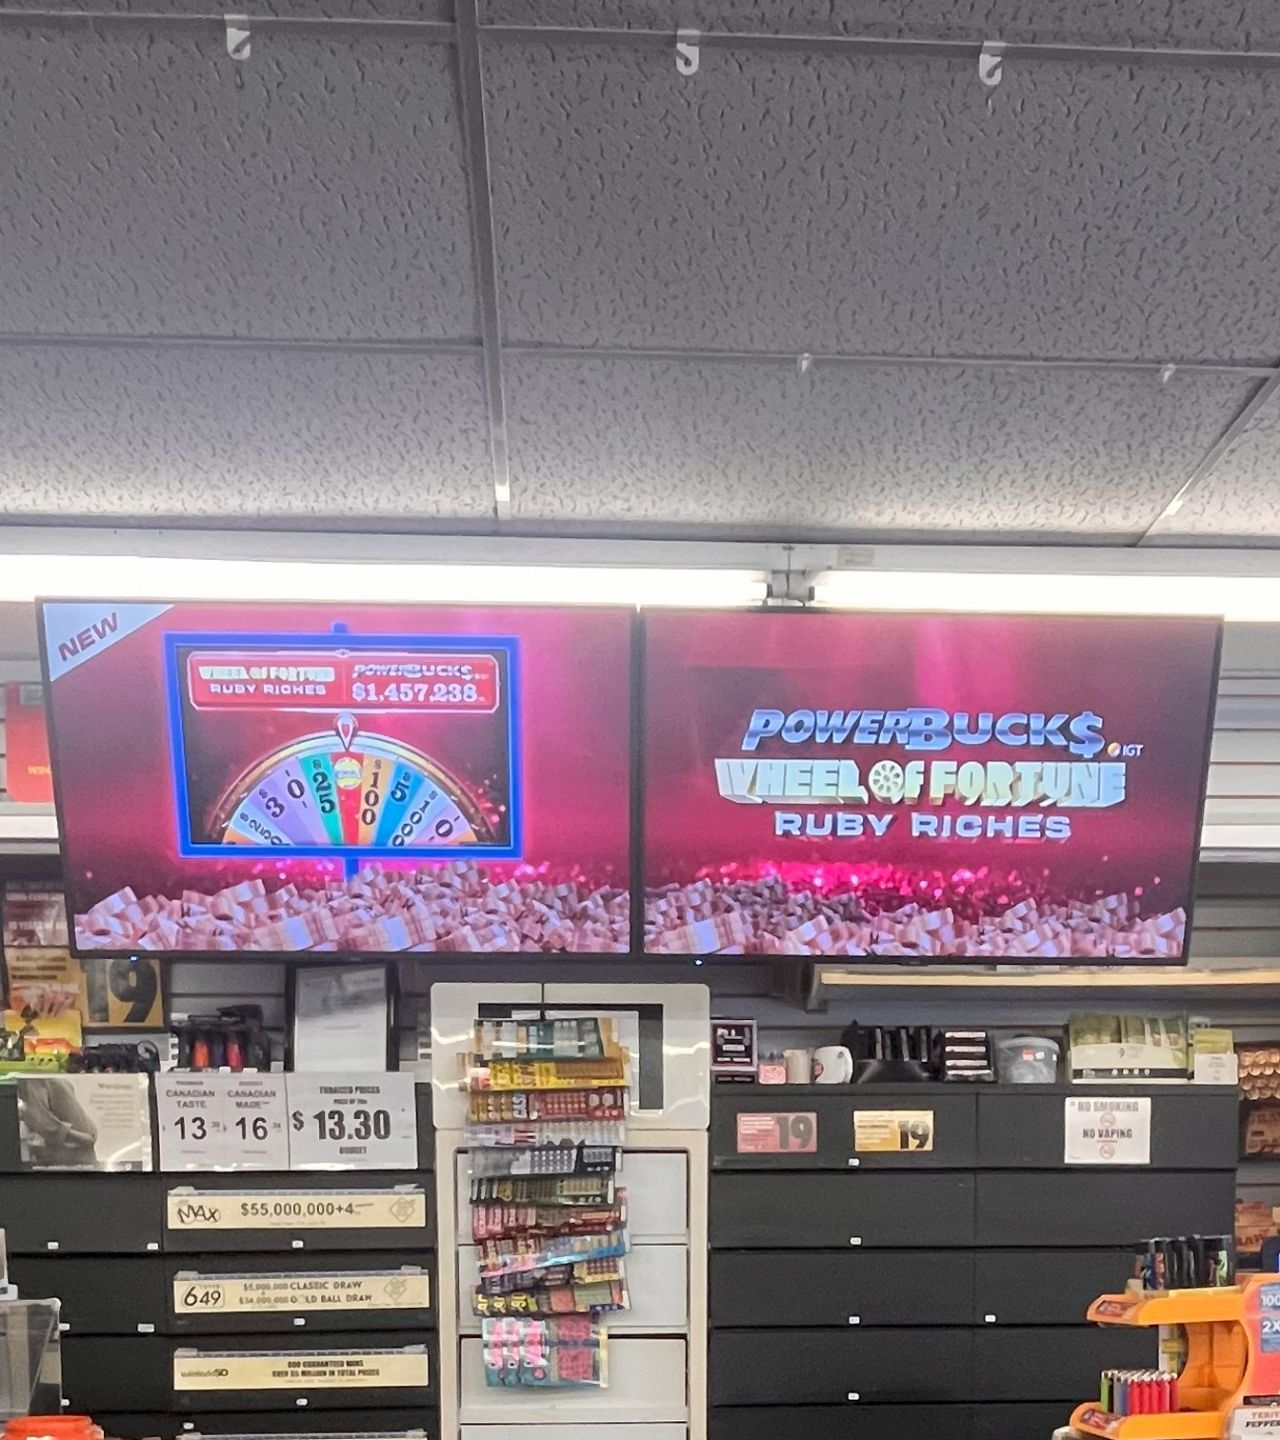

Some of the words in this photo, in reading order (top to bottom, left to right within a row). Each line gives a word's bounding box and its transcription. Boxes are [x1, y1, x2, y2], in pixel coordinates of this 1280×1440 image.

[57, 612, 120, 661] NEW
[209, 684, 256, 695] RUBY
[263, 684, 327, 696] RICHES
[352, 682, 479, 703] $1,457,238
[1121, 743, 1144, 757] IGT
[715, 759, 869, 805] WHEEL
[925, 760, 1126, 806] FORTUNE
[774, 810, 894, 838] RUBY
[911, 812, 1072, 840] RICHES
[166, 1089, 216, 1098] CANADIAN
[227, 1089, 277, 1098] CANADIAN
[176, 1100, 207, 1109] TASTE
[174, 1116, 208, 1140] 13
[235, 1116, 269, 1140] 16
[292, 1110, 305, 1132] $
[313, 1109, 392, 1141] 13.30
[776, 1115, 814, 1150] 19
[897, 1120, 931, 1149] 19
[1082, 1128, 1096, 1139] NO
[1097, 1128, 1133, 1139] VAPING
[183, 1285, 222, 1307] 649
[333, 1281, 363, 1291] DRAW
[346, 1294, 373, 1303] DRAW
